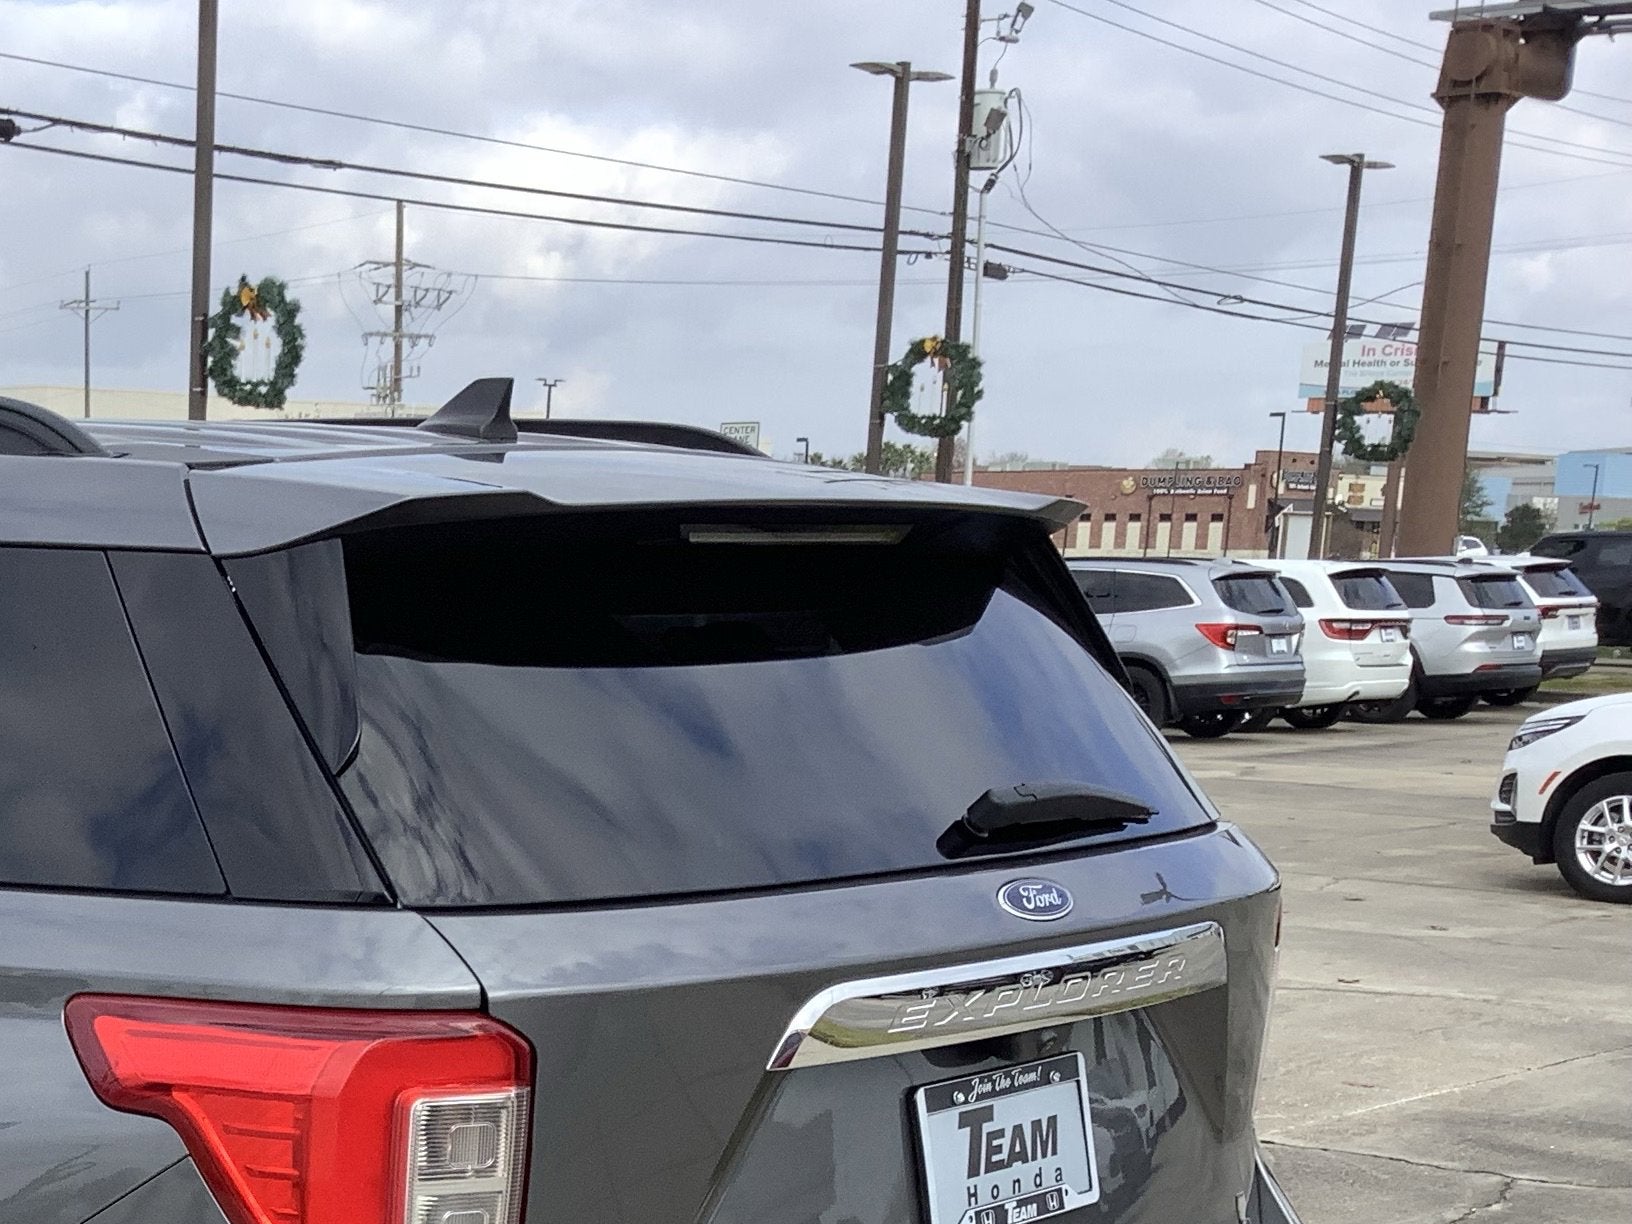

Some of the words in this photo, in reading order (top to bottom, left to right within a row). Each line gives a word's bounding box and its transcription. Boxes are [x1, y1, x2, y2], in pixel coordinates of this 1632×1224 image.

[1361, 344, 1376, 357] In
[1314, 360, 1350, 368] Meal
[1352, 359, 1387, 368] Health
[724, 426, 756, 436] CENTER
[1205, 476, 1214, 487] &
[1019, 884, 1062, 908] Ford
[887, 957, 1187, 1034] EXPLORER
[968, 1078, 993, 1103] Join
[992, 1072, 1011, 1092] The
[1011, 1065, 1042, 1087] Team!
[967, 1167, 1064, 1207] Honda
